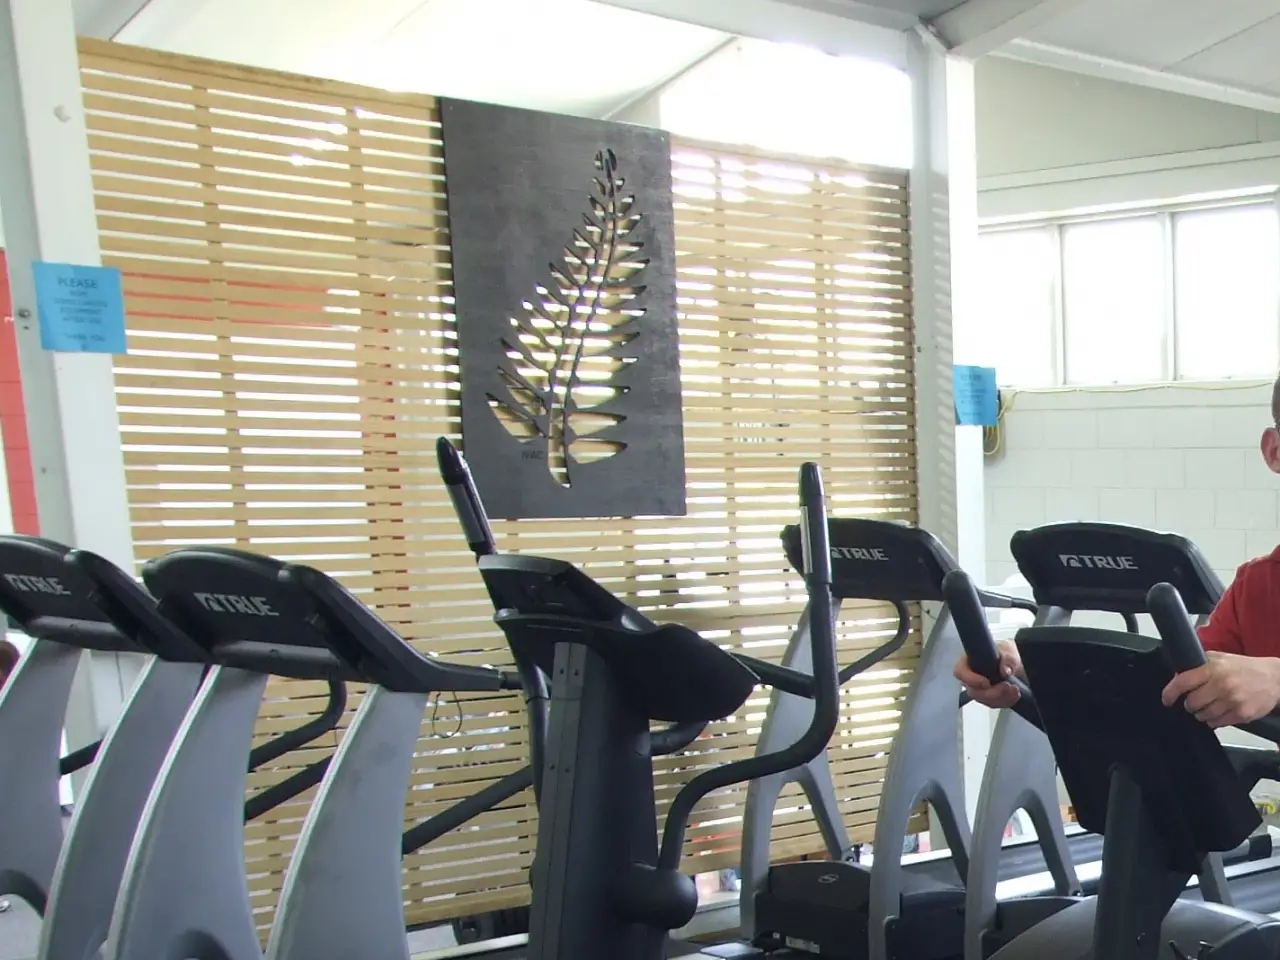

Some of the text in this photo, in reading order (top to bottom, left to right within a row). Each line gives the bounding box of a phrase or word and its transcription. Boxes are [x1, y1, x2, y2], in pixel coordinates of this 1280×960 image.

[57, 276, 98, 289] PLEASE
[838, 546, 890, 561] TRUE
[1077, 554, 1139, 570] TRUE
[23, 575, 72, 596] TRUE
[214, 594, 280, 617] TRUE
